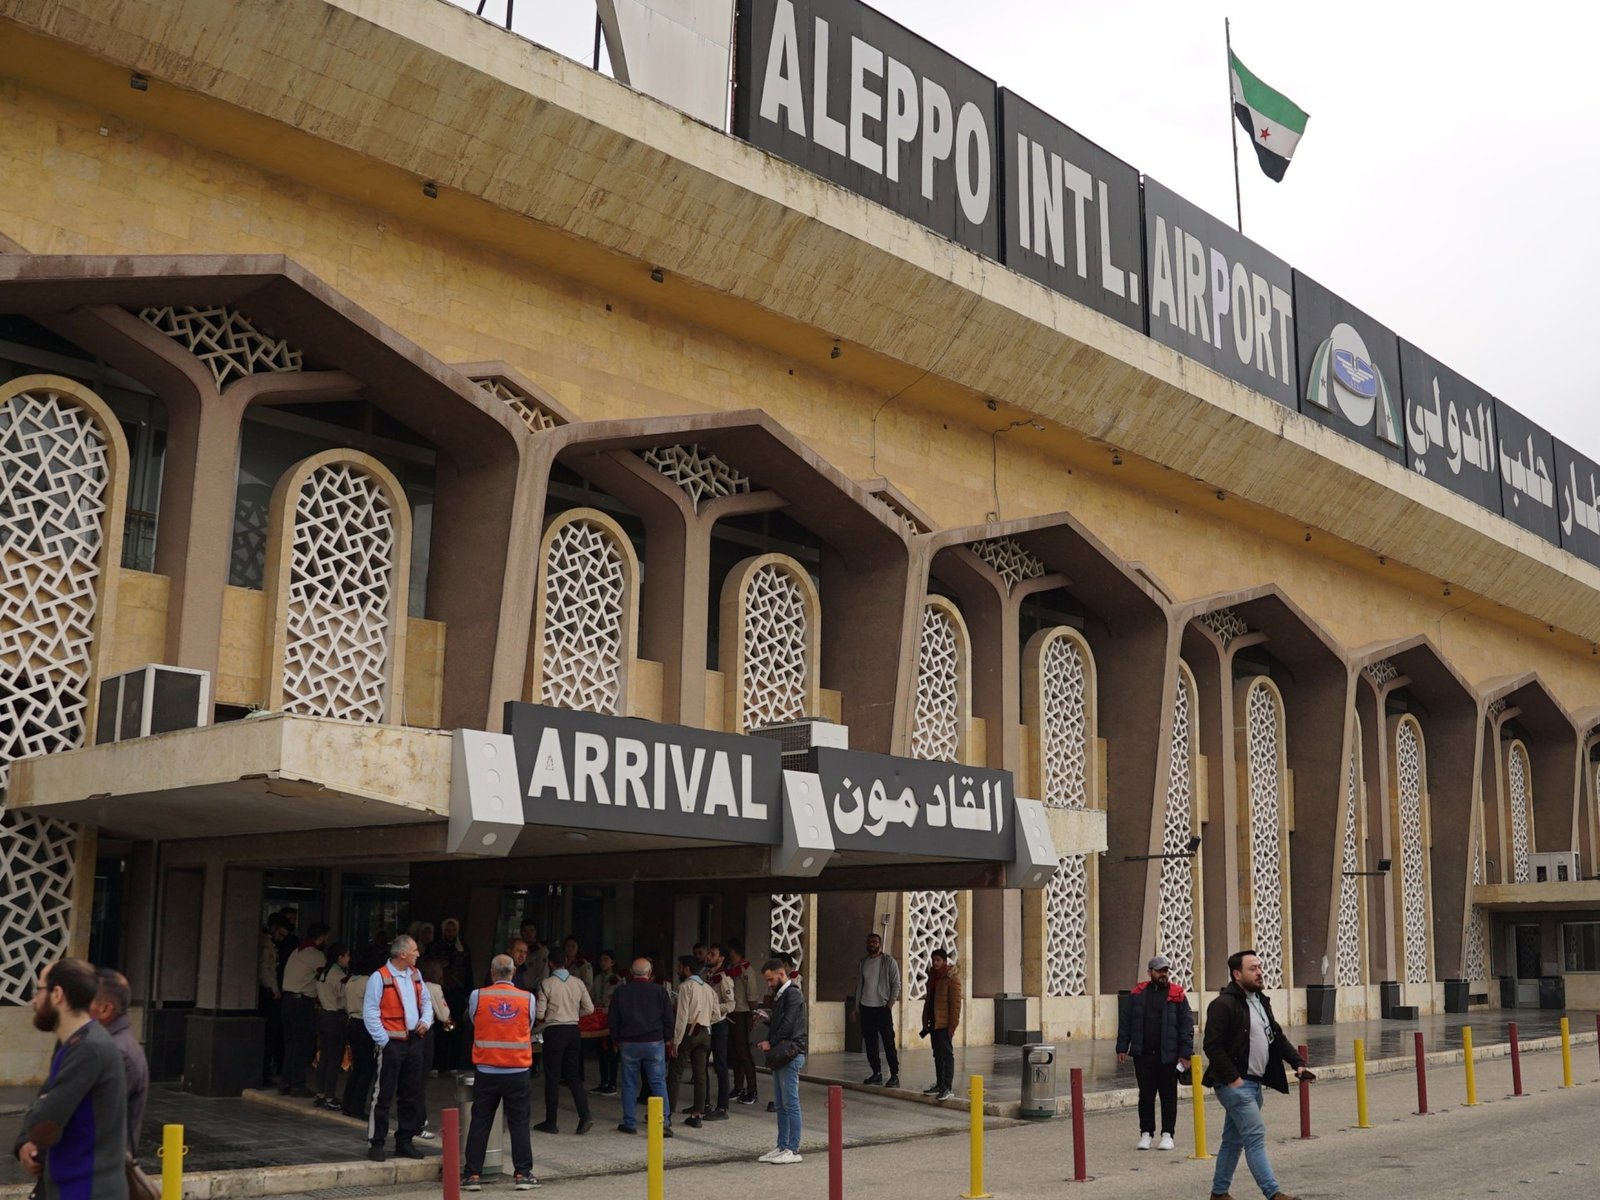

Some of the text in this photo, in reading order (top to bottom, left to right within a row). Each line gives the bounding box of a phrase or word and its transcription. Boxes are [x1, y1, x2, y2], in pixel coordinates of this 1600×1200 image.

[760, 0, 1293, 386] ALEPPO INTL. AIRPORT
[1406, 376, 1495, 475] الدولي
[1499, 434, 1553, 508] حلب
[528, 727, 768, 819] ARRIVAL
